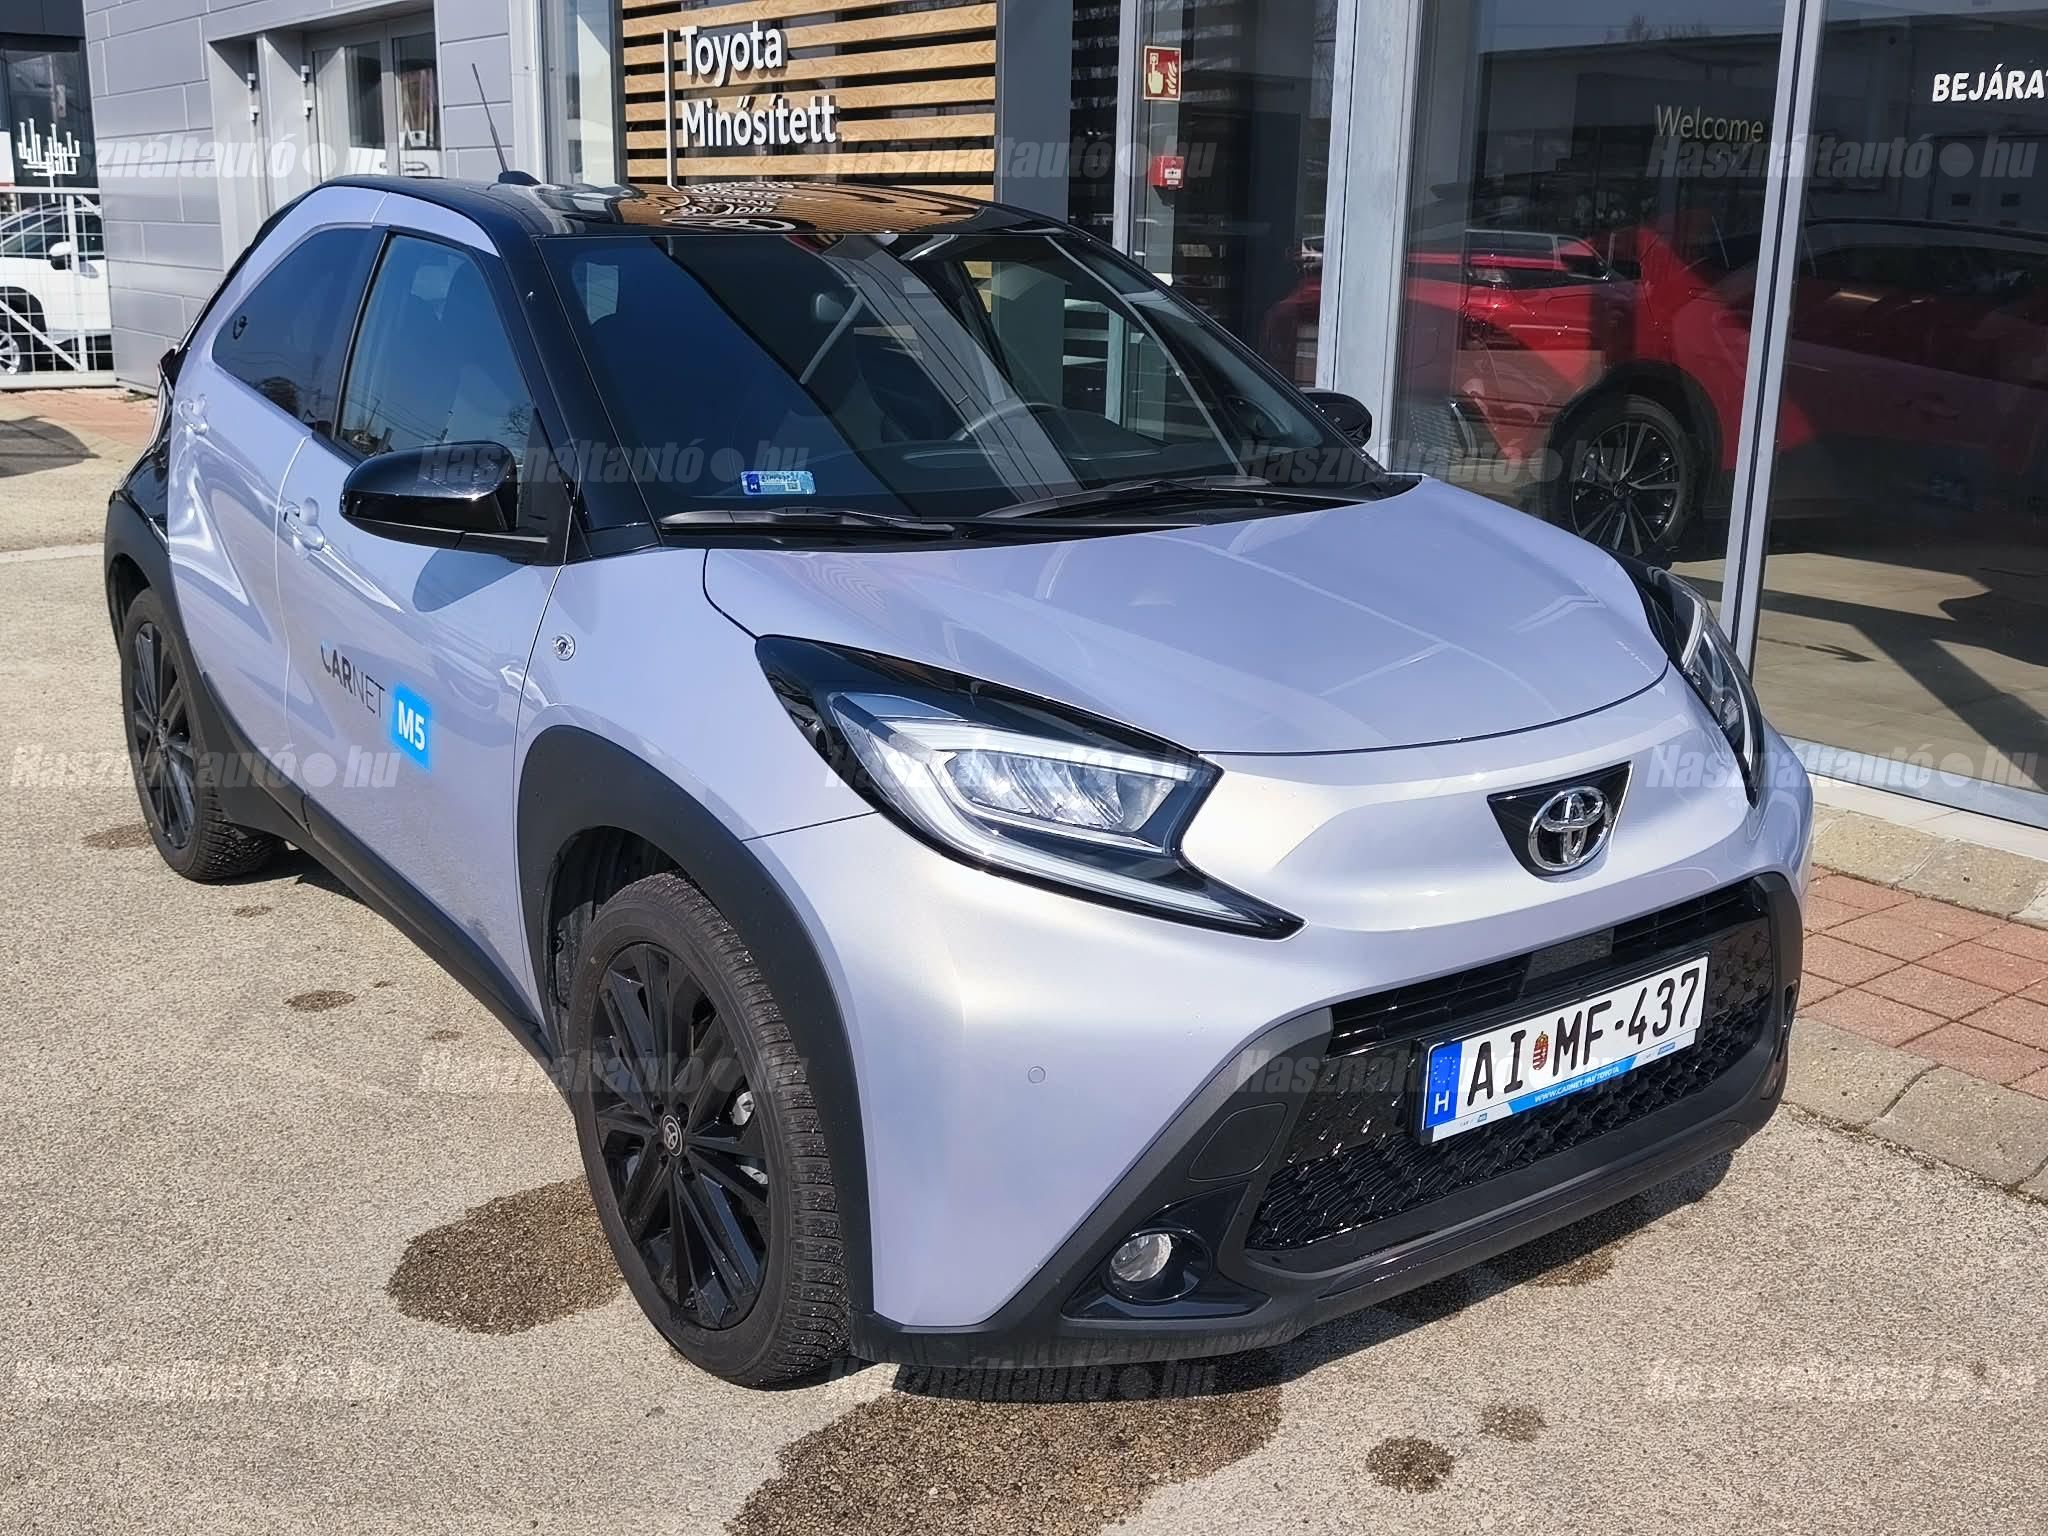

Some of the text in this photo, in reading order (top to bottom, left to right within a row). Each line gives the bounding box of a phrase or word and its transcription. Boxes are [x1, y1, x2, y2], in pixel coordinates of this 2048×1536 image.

[680, 20, 785, 87] Toyota
[1932, 63, 2048, 102] BEJÁRA
[681, 94, 839, 148] Minősített
[1656, 103, 1764, 143] Welcome
[398, 699, 426, 751] M5
[1467, 967, 1701, 1106] AI MF-437
[1433, 1089, 1450, 1115] H
